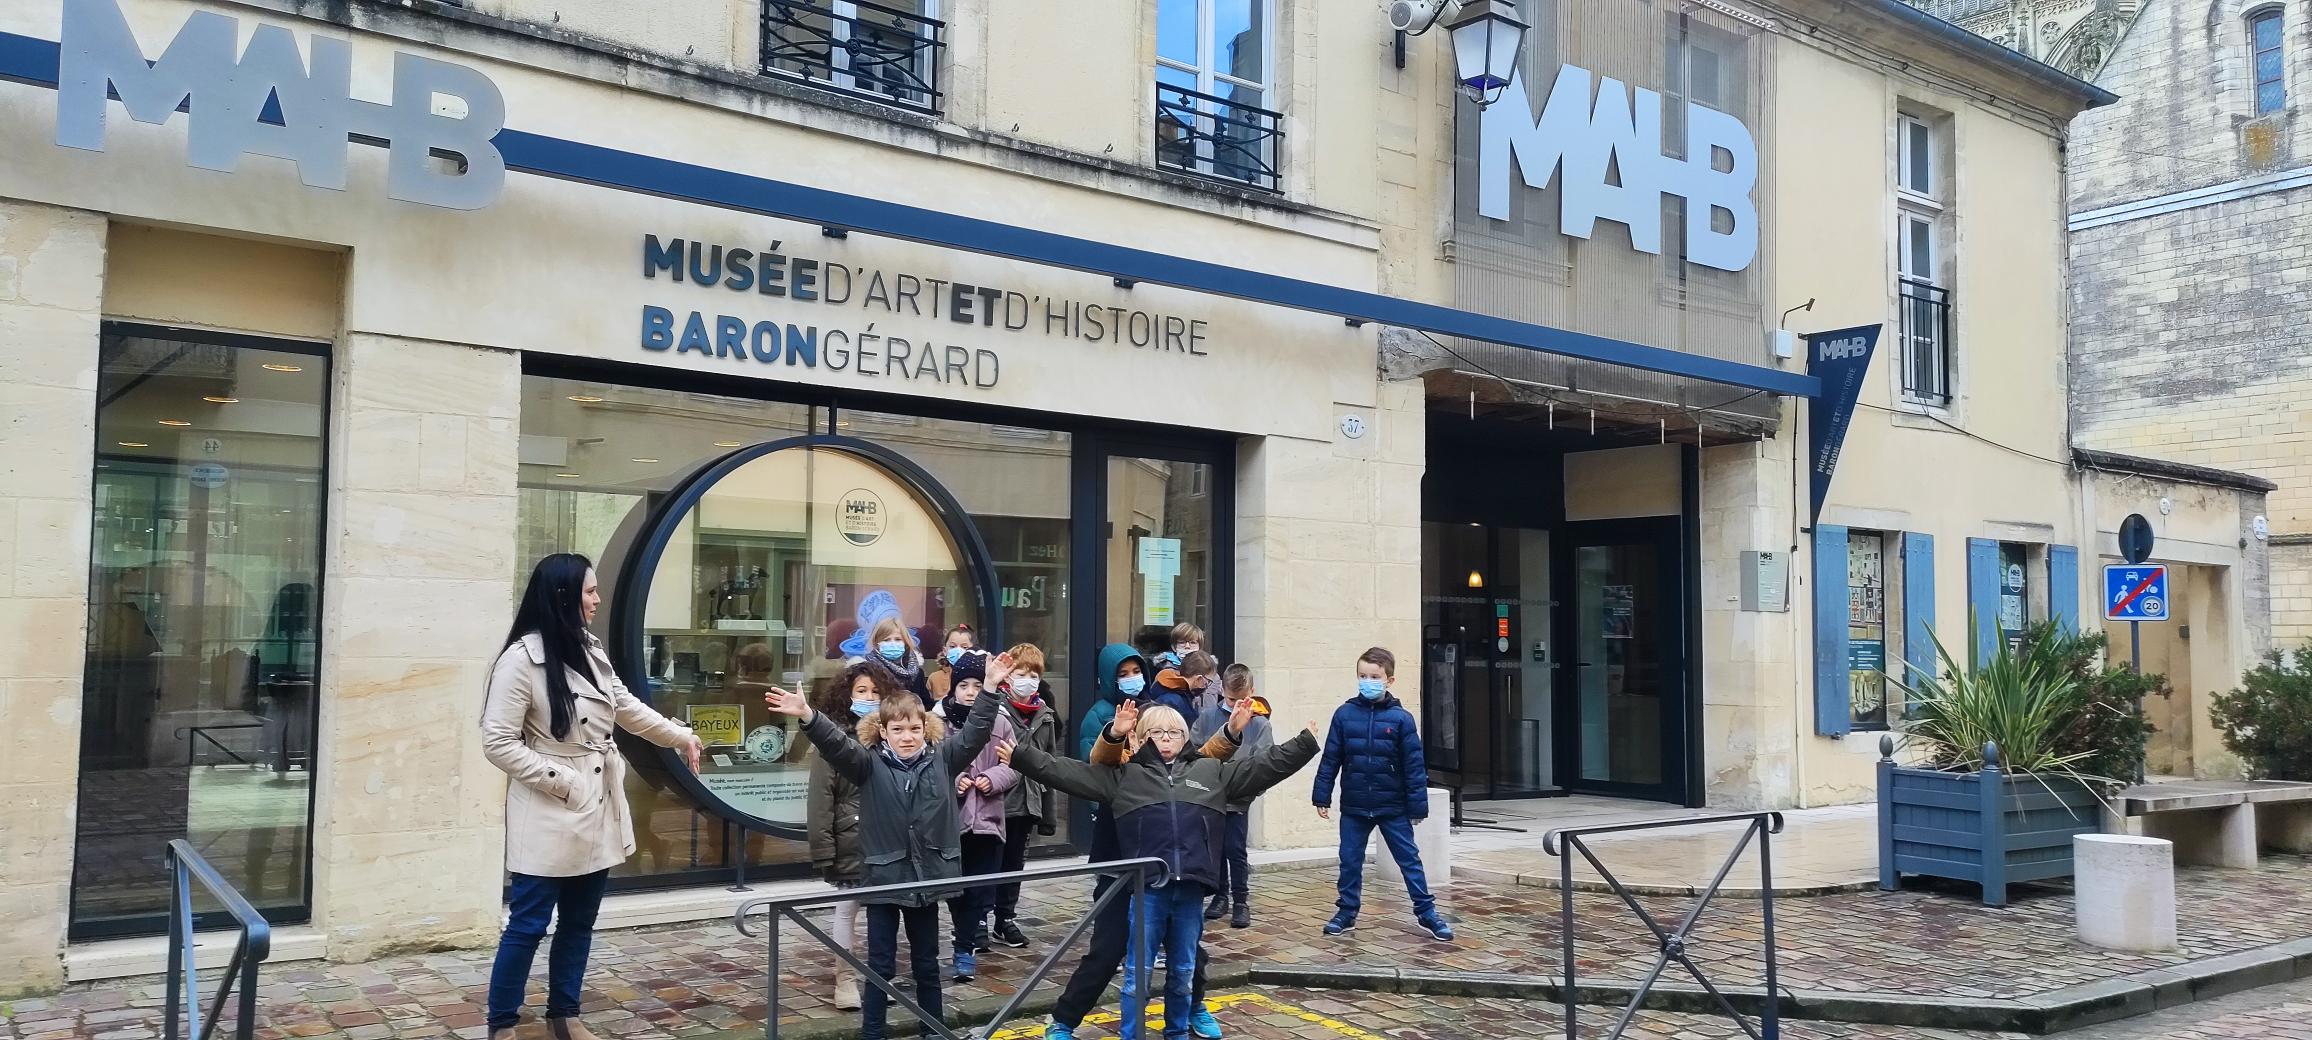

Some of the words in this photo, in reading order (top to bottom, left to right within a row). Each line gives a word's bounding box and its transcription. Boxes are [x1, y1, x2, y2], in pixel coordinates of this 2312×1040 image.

[55, 0, 506, 211] MAHB
[1479, 63, 1758, 271] MAHB
[1819, 336, 1867, 362] MAHB
[1347, 418, 1360, 433] 37
[2146, 602, 2159, 610] 20
[692, 720, 740, 731] BAYEUX
